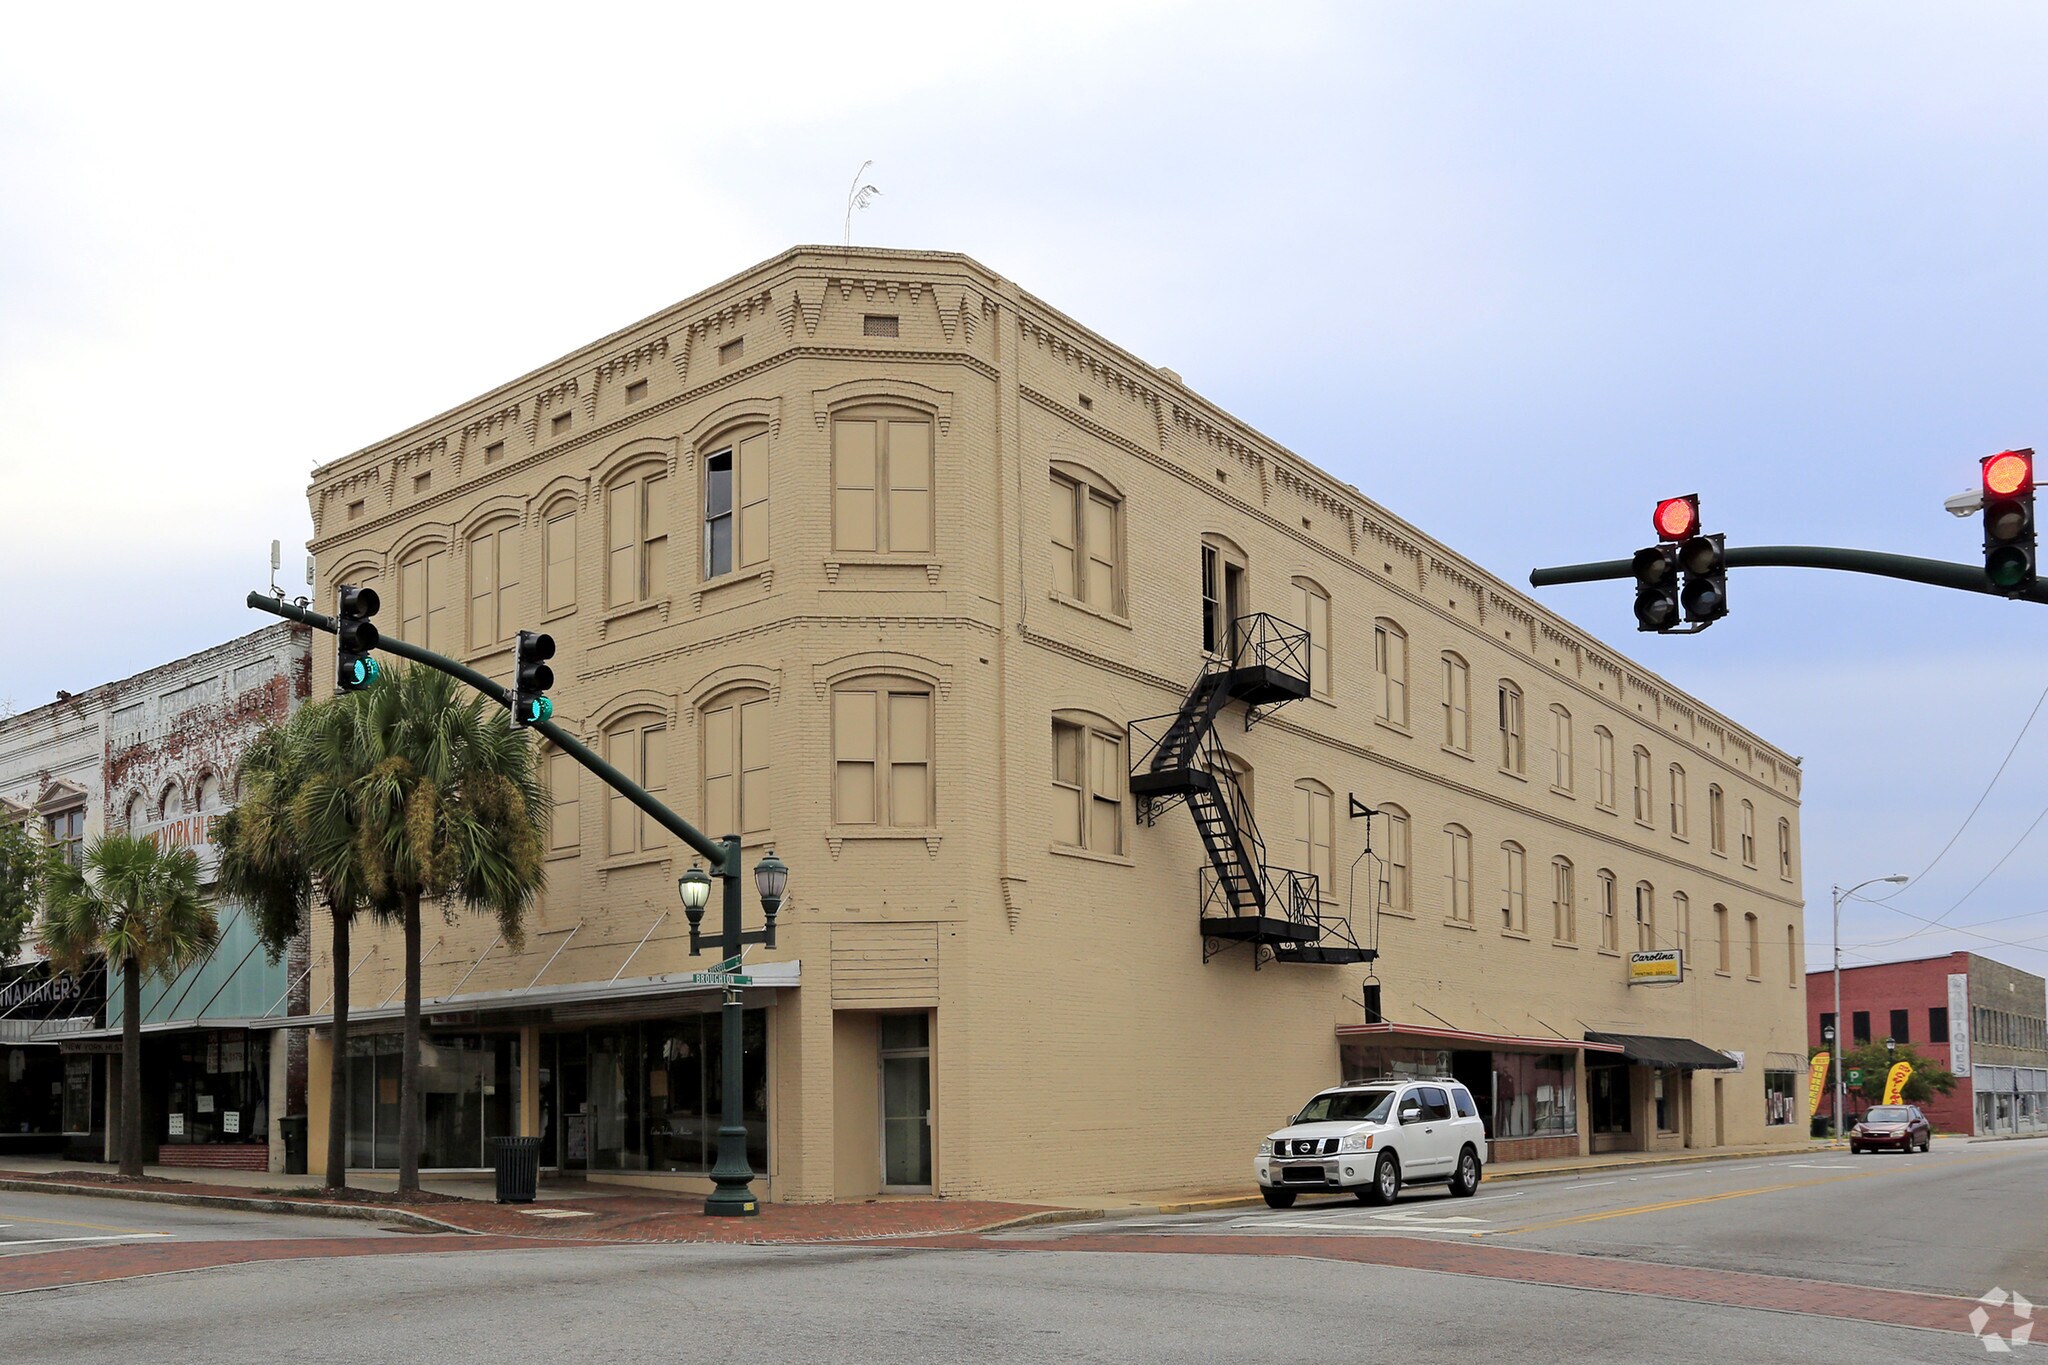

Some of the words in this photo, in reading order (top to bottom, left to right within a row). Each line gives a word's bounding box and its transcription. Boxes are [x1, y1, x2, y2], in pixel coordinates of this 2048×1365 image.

[162, 818, 190, 850] YORK
[193, 815, 204, 845] HI
[1632, 952, 1675, 962] Carolina
[696, 974, 734, 984] BROUGHTON
[65, 1042, 81, 1051] NEW
[84, 1042, 103, 1051] YORK
